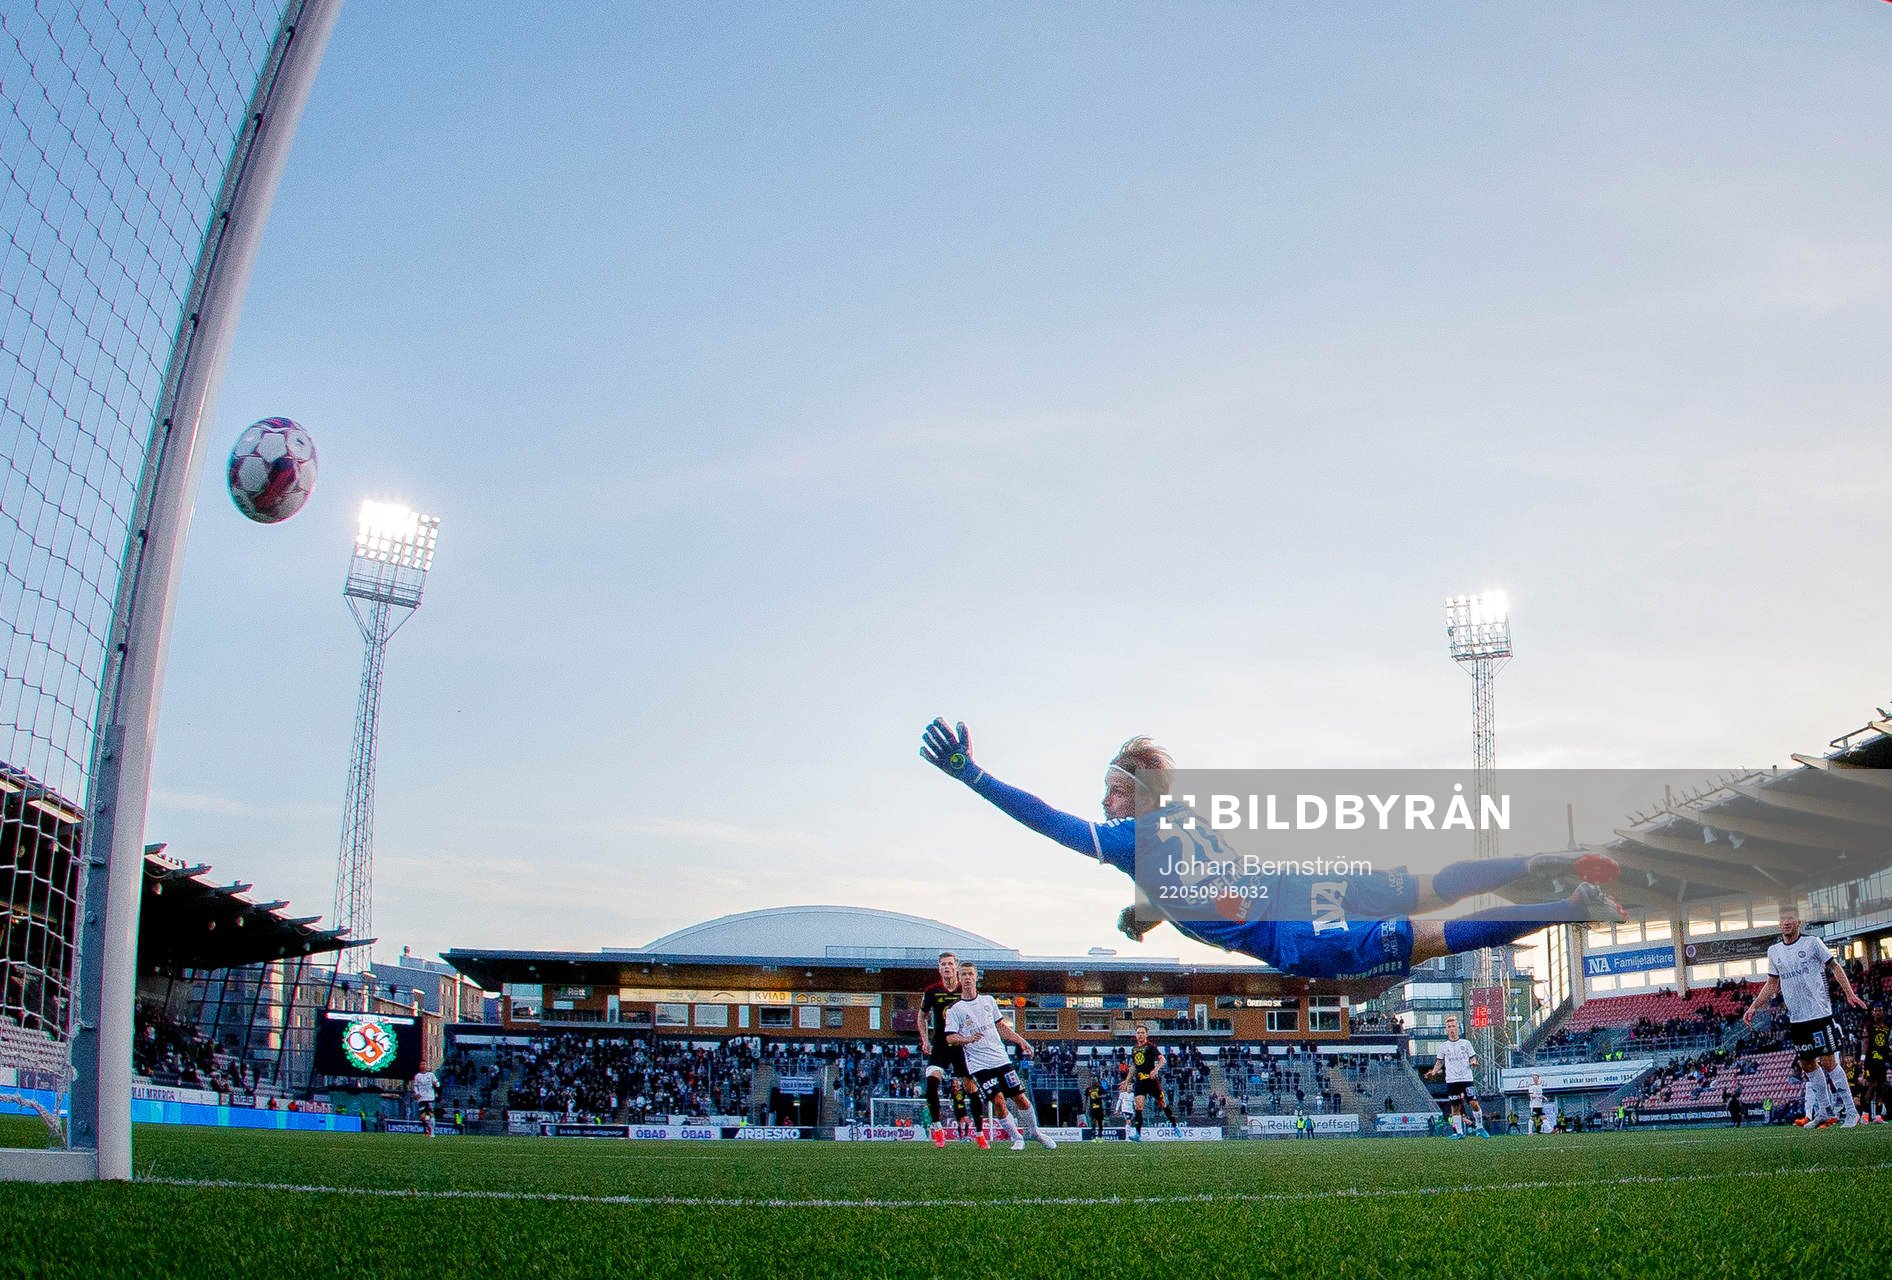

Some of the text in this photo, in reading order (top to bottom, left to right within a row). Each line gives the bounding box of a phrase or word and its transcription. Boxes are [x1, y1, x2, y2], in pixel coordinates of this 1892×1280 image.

[1311, 880, 1350, 937] NA
[1588, 953, 1674, 974] NA Familjeläktare
[636, 1127, 667, 1139] ÖBAB
[681, 1127, 712, 1139] ÖBAB
[735, 1128, 800, 1140] ARBESKO
[1157, 1129, 1194, 1137] ORRYS
